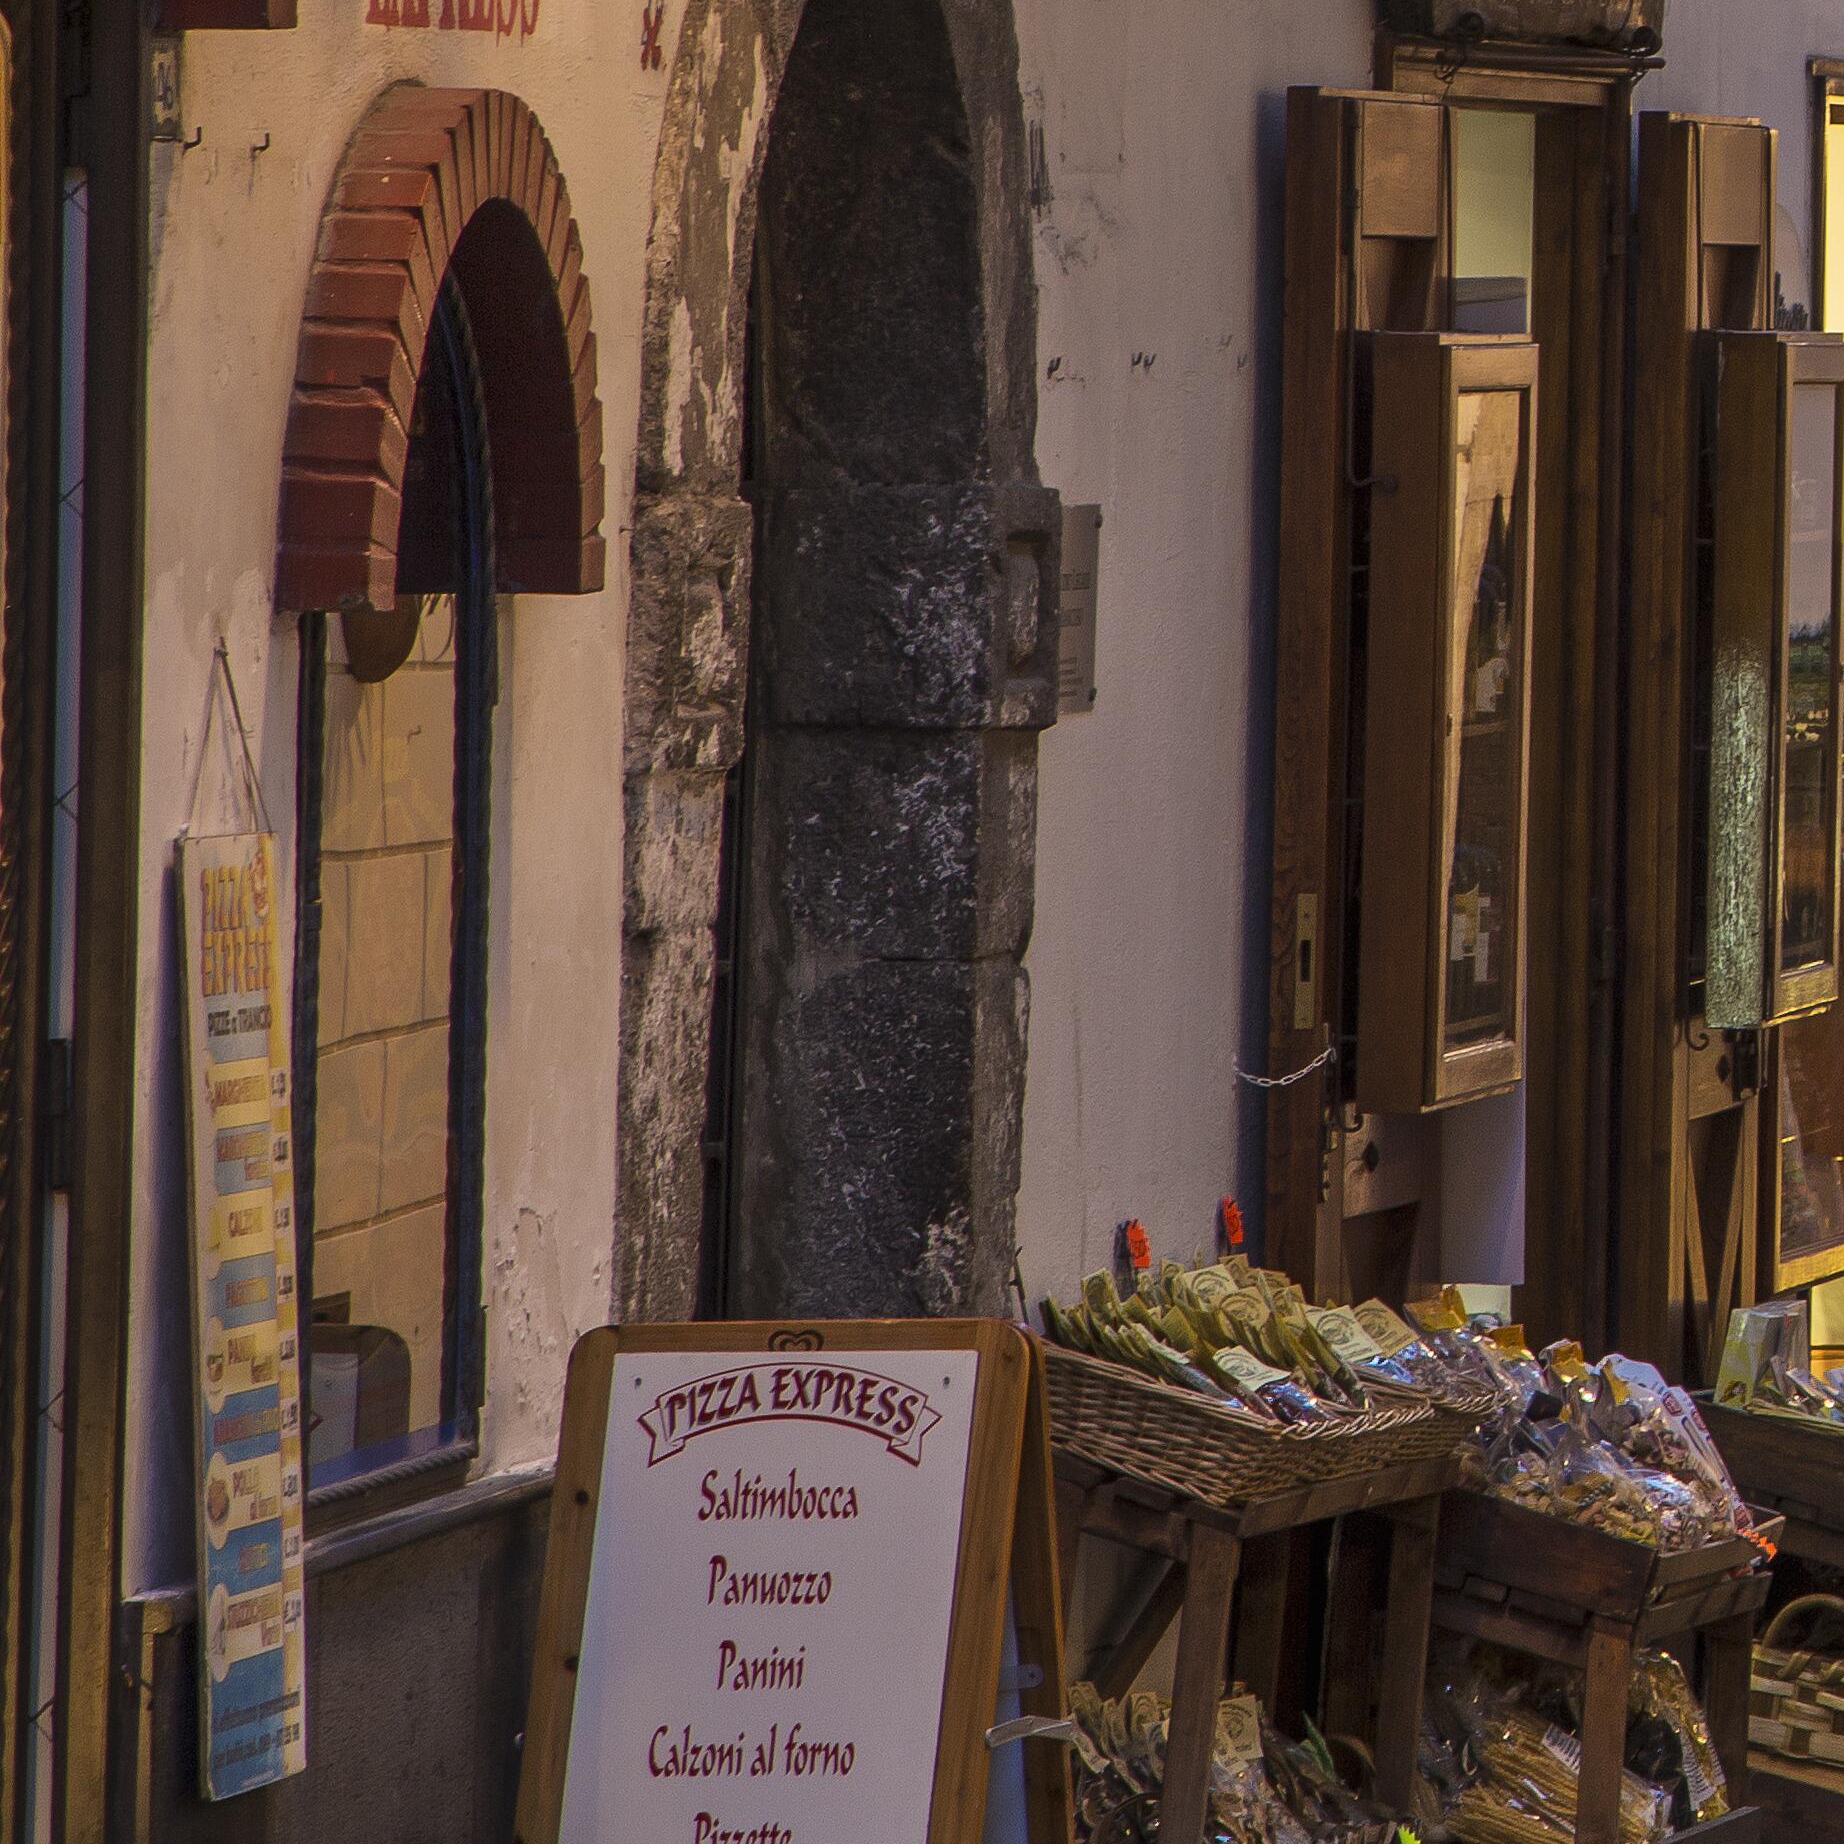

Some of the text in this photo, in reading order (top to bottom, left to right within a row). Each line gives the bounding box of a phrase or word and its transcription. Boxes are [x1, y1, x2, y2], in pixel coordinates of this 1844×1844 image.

[201, 866, 251, 933] PIZZA
[665, 1367, 922, 1436] PIZZA EXPRESS
[698, 1469, 858, 1521] Saltimbocca
[707, 1555, 832, 1606] Panuozzo
[717, 1640, 806, 1691] Panini
[648, 1723, 856, 1778] Calzoni al forno
